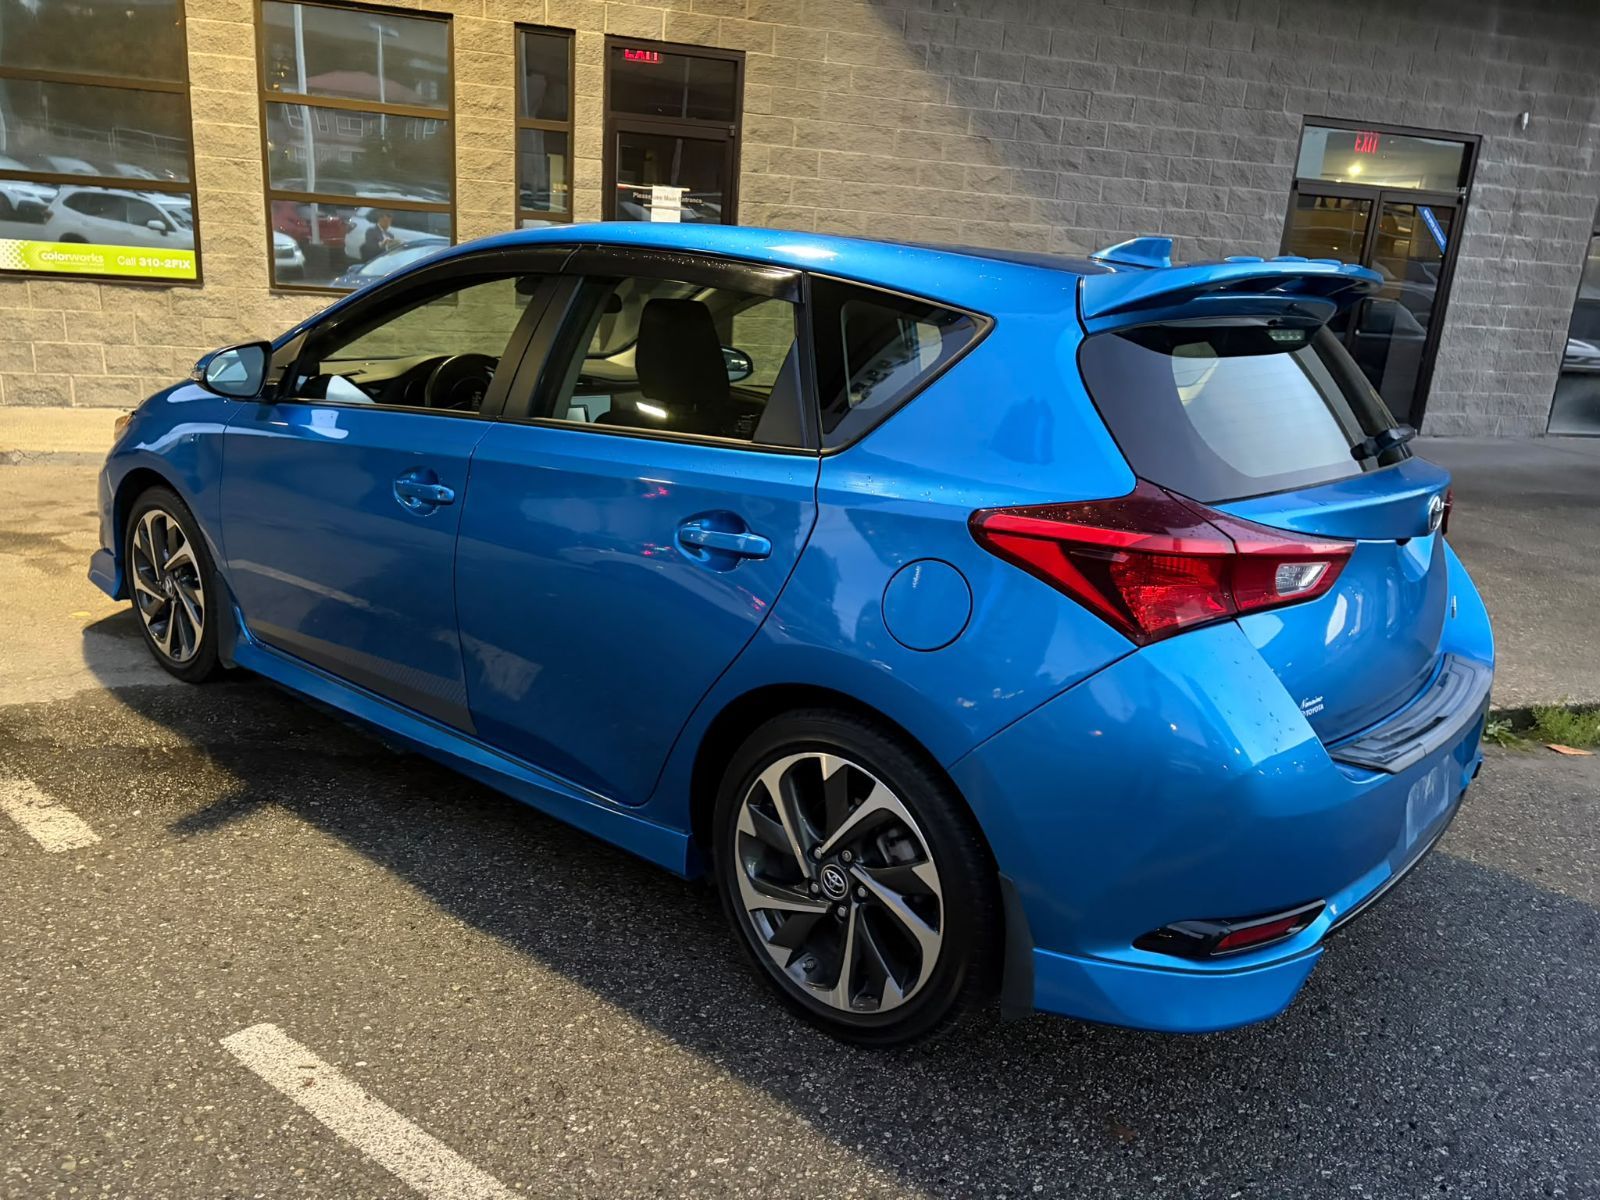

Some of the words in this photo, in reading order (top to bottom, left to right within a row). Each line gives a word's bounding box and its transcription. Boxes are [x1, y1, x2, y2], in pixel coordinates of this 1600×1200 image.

[41, 251, 104, 263] colorworks
[117, 255, 136, 267] Call
[139, 257, 191, 269] 310-2FIX
[1306, 703, 1324, 717] TOYOTA
